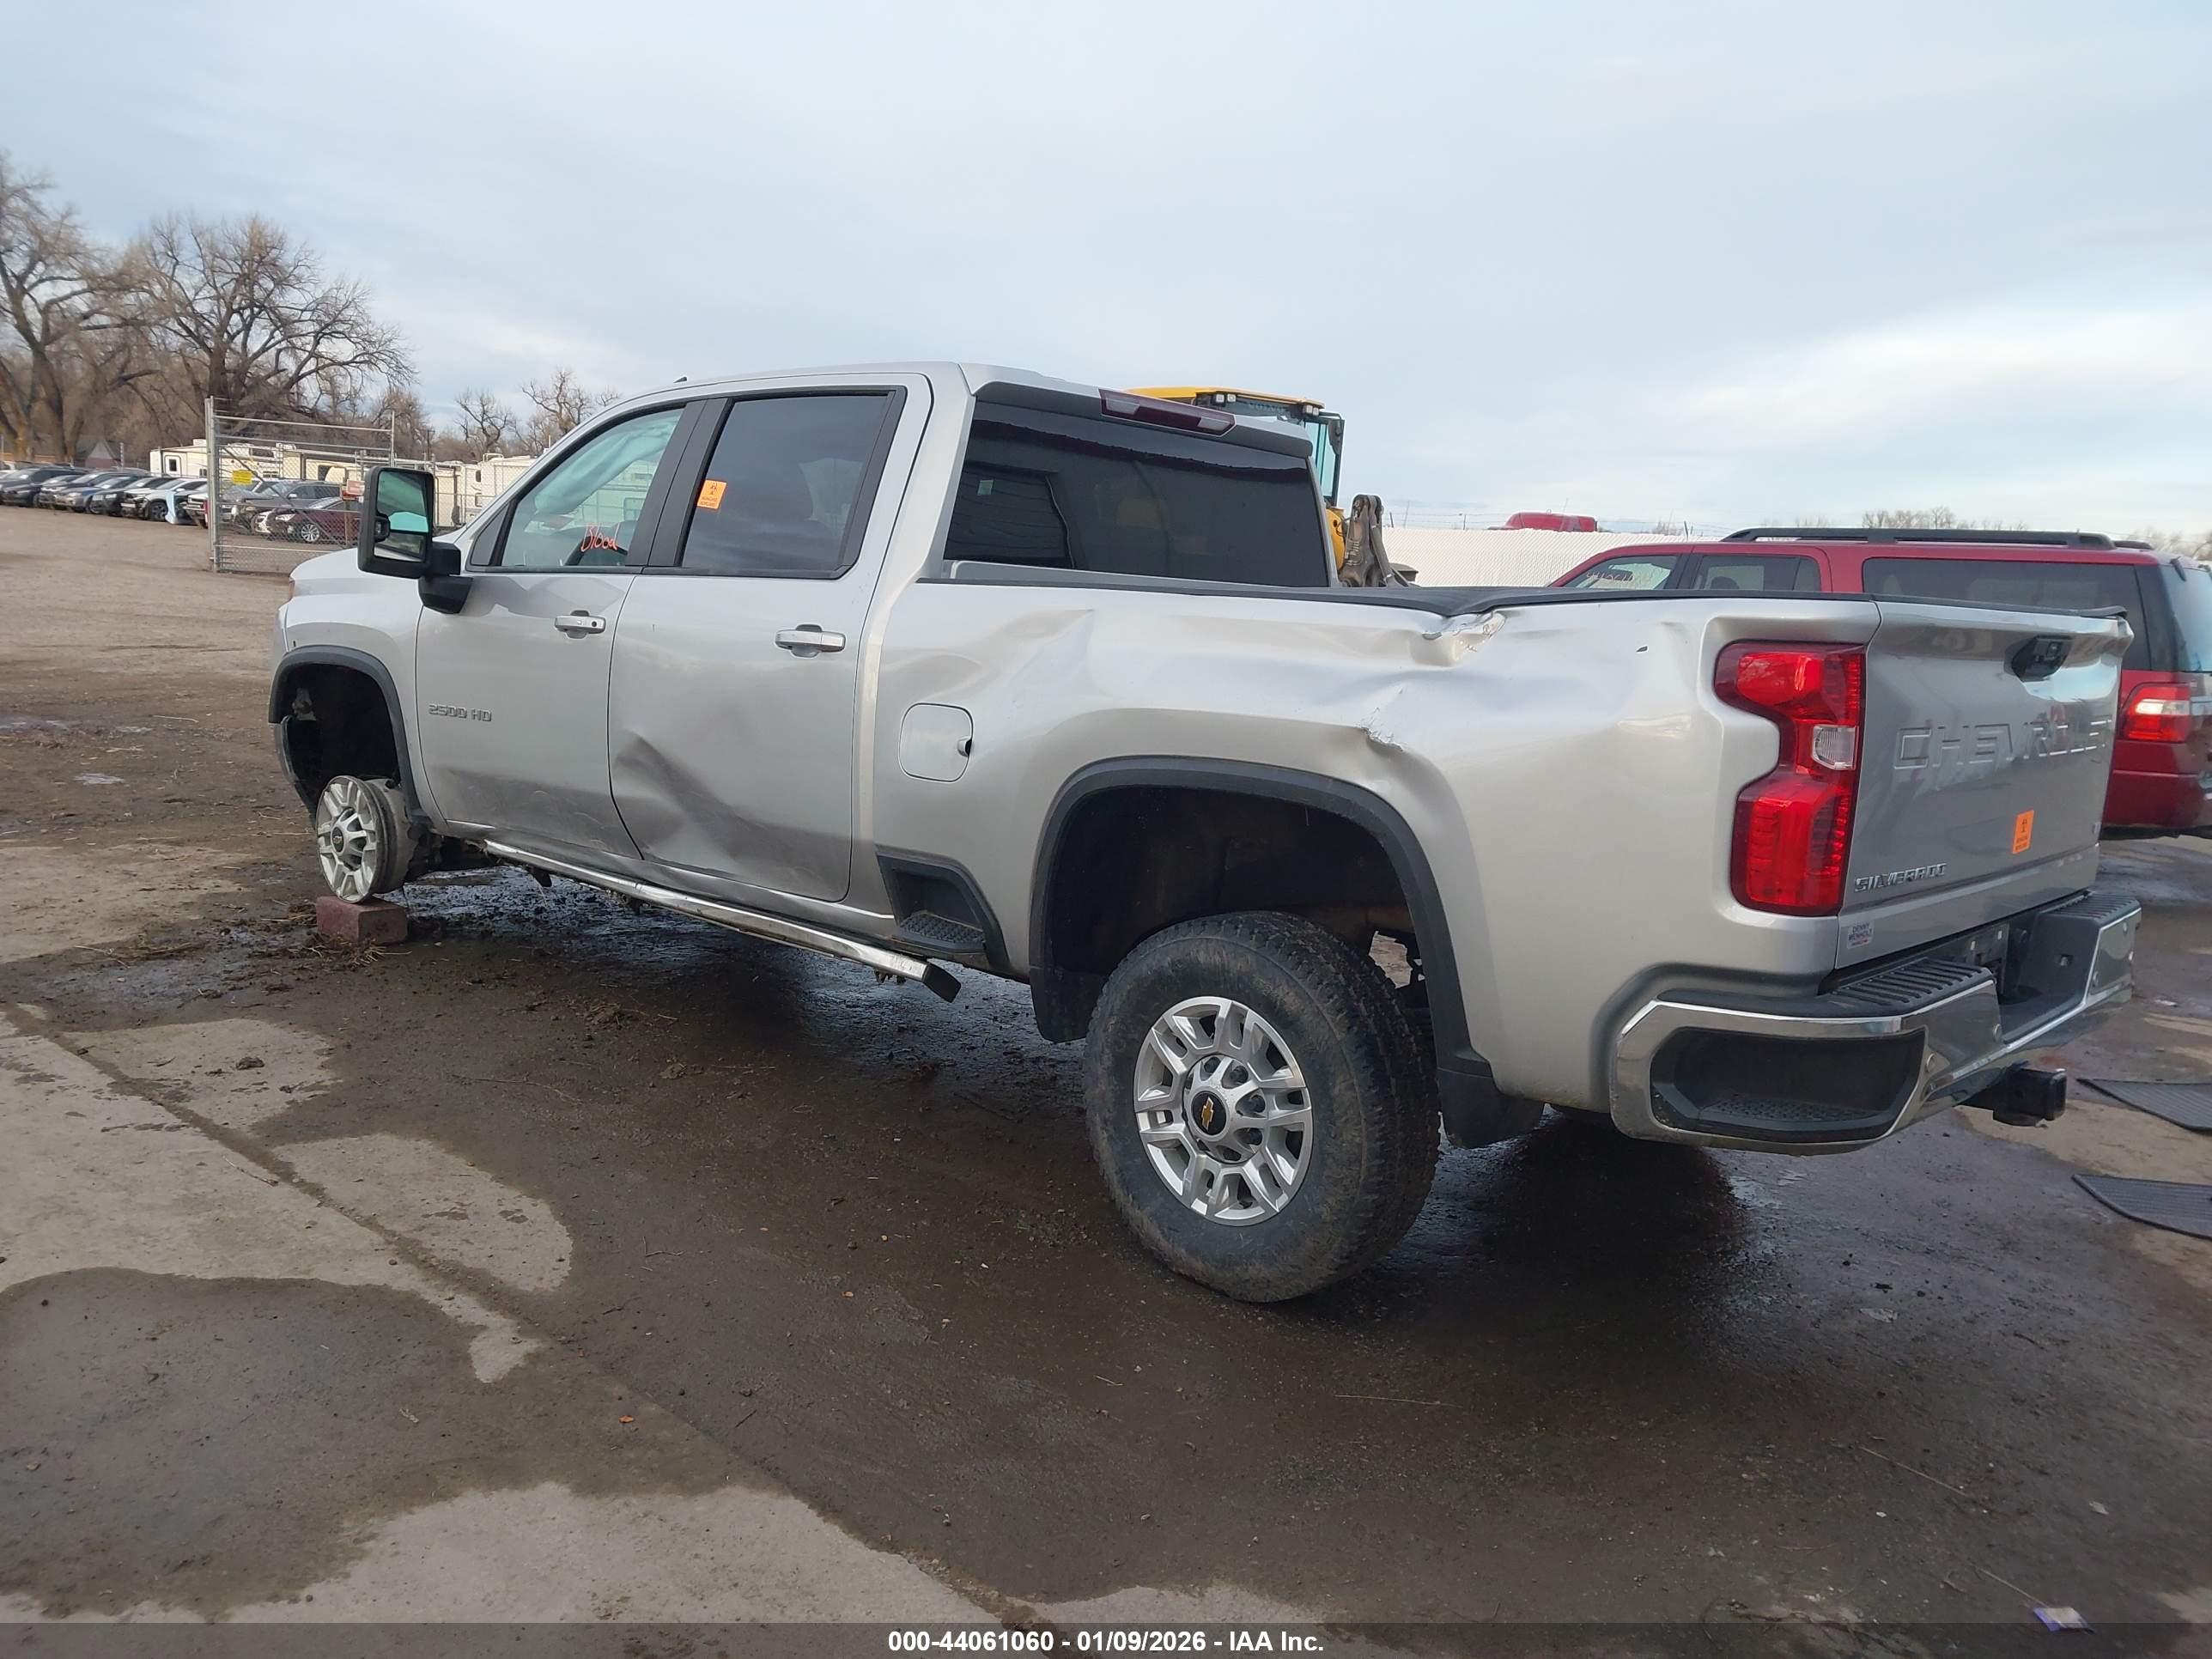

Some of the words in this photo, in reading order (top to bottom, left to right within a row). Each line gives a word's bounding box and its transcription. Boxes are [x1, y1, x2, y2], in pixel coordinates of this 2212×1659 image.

[428, 703, 467, 719] 2500
[471, 708, 492, 722] HD
[1854, 862, 1948, 893] SILVERADO
